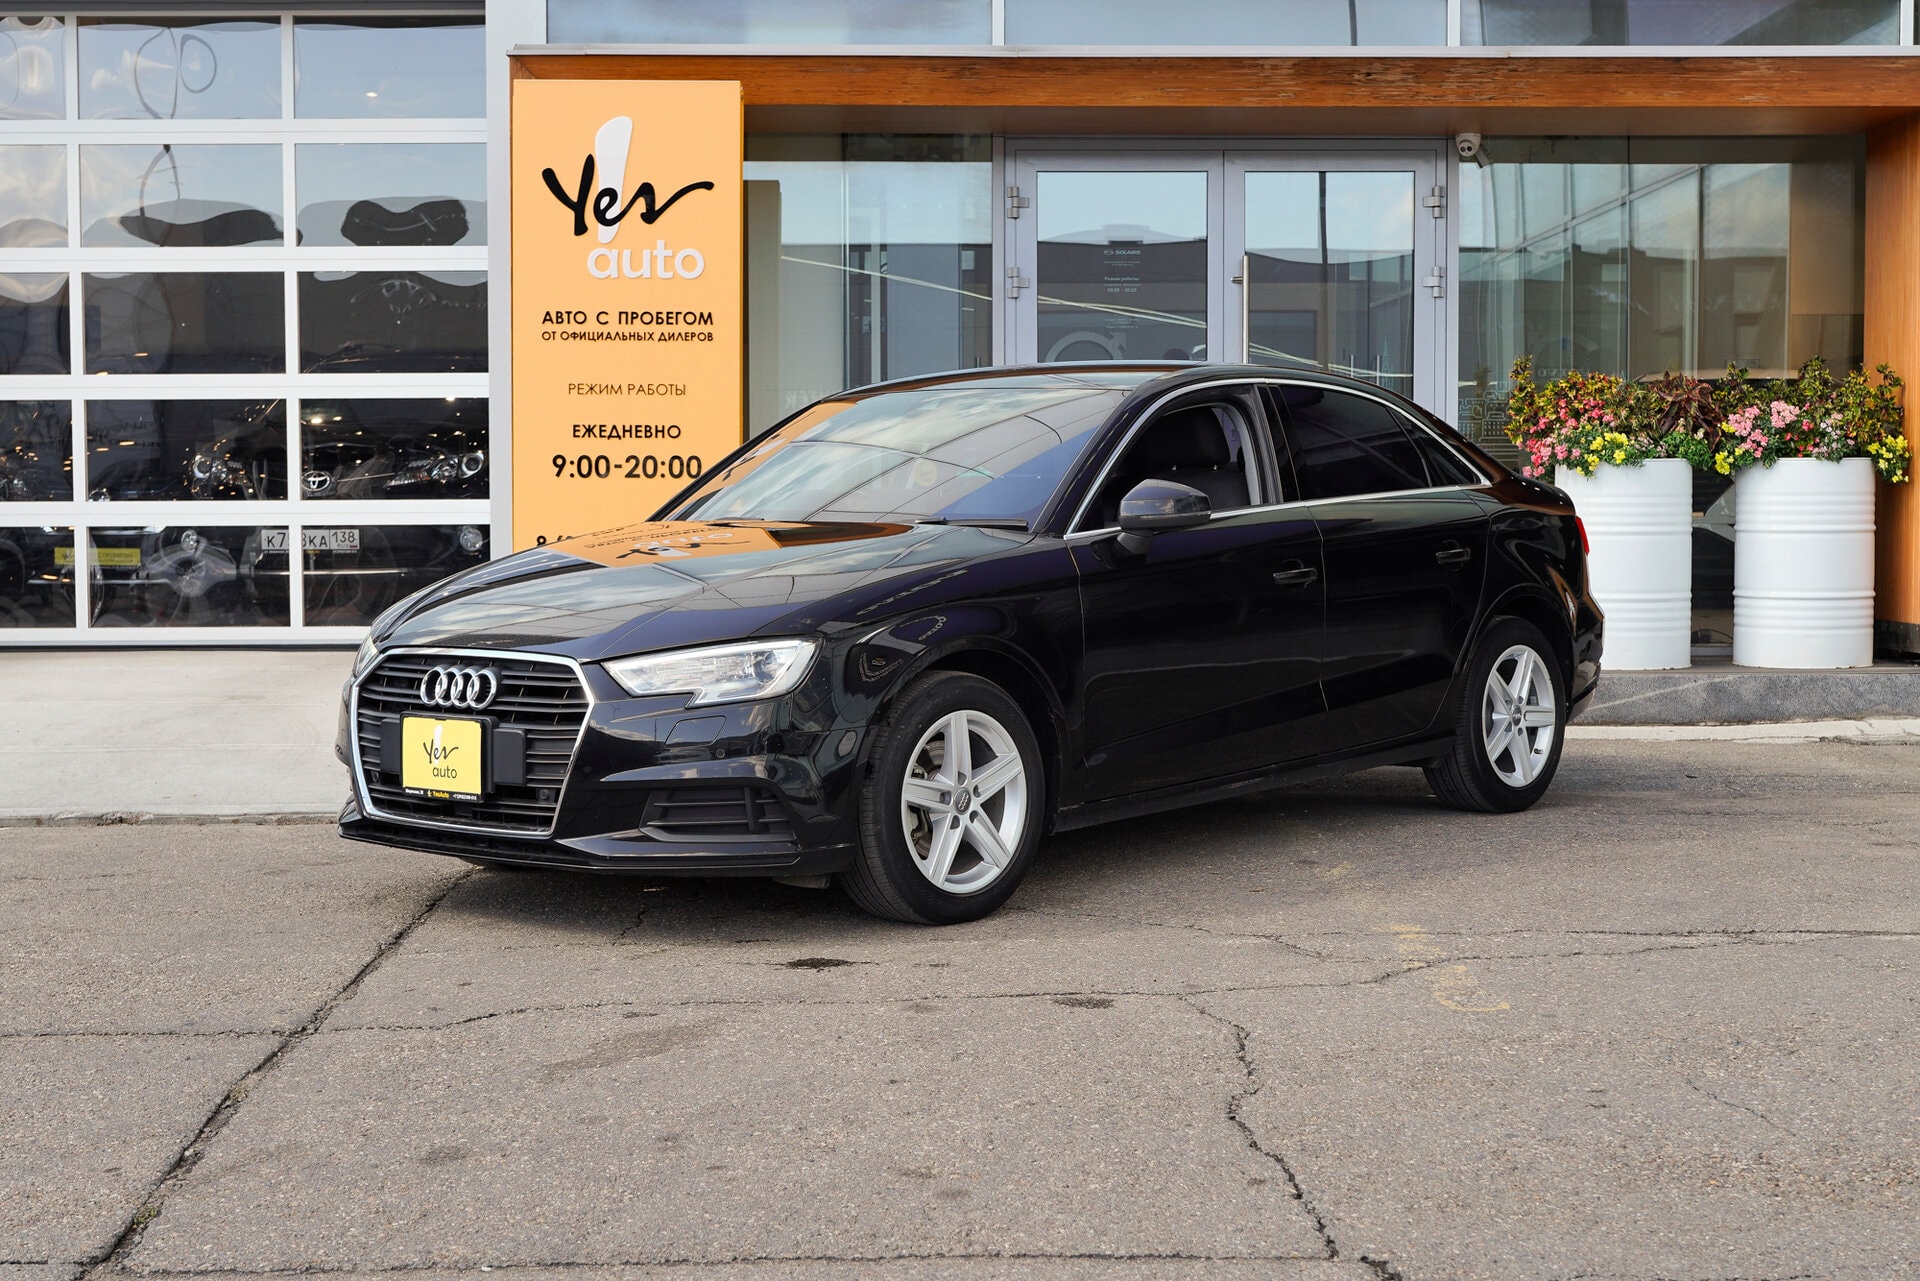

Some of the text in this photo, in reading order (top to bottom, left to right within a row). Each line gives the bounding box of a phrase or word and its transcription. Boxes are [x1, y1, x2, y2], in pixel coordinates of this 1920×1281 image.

[542, 153, 715, 237] Yes
[587, 240, 705, 279] auto
[541, 311, 714, 326] АВТО С ПРОБЕГОМ
[541, 331, 714, 342] ОТ ОФИЦИАЛЬНЫХ ДИЛЕРОВ
[568, 383, 687, 396] РЕЖИМ РАБОТЫ
[572, 424, 682, 440] ЕЖЕДНЕВНО
[552, 454, 703, 479] 9:00-20:00
[331, 531, 356, 544] 138
[432, 765, 458, 779] auto
